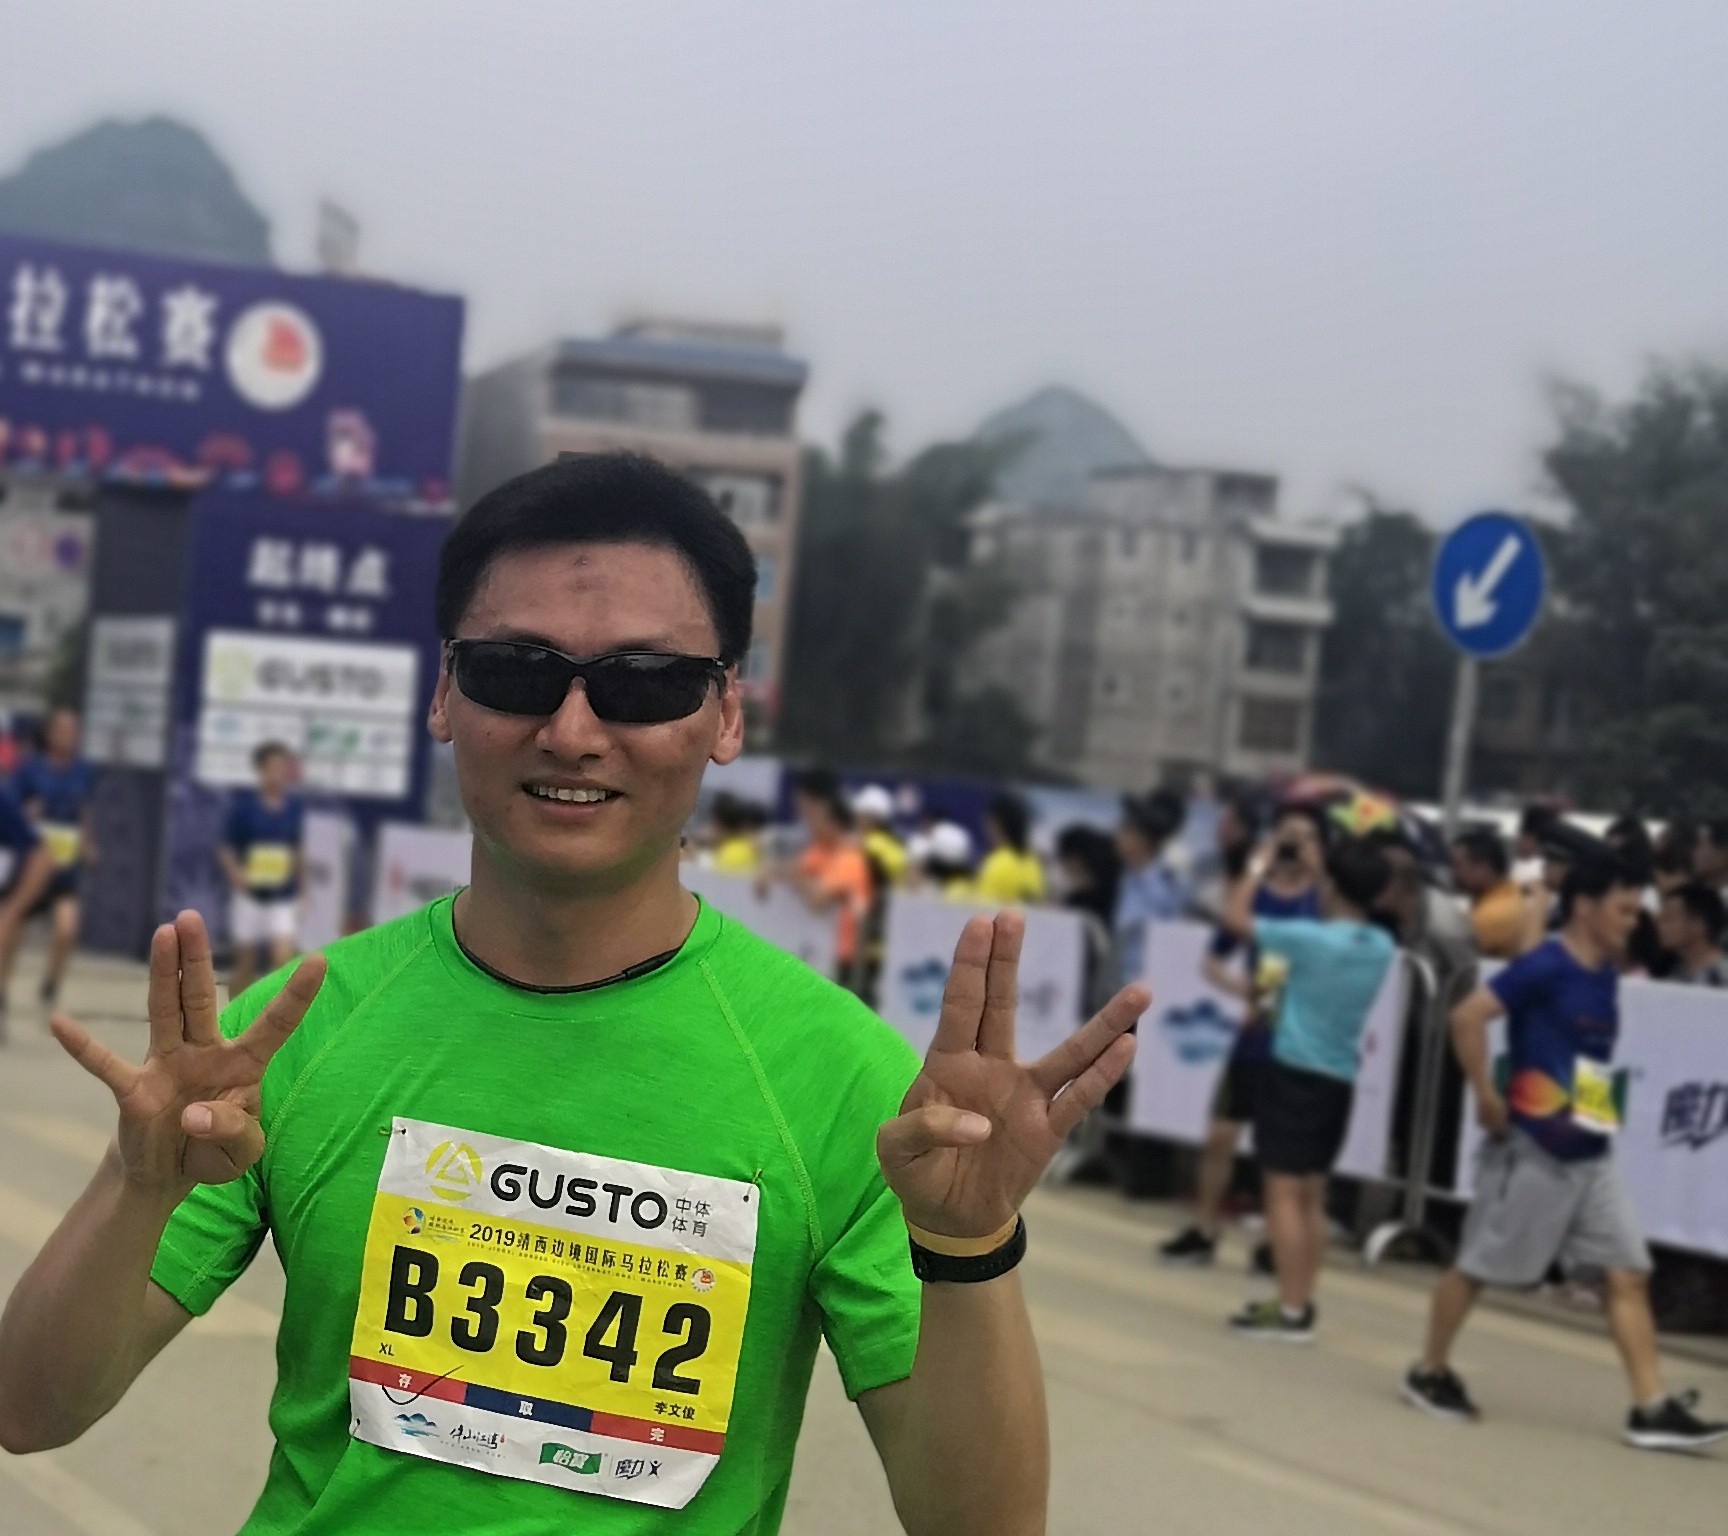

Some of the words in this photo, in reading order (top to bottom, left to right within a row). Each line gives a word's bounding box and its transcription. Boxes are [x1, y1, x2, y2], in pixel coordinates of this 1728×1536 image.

[256, 657, 385, 700] GUSTO
[490, 1163, 668, 1230] GUSTO
[675, 1197, 711, 1218] 中体
[671, 1216, 708, 1238] 体育
[469, 1222, 689, 1282] 2019靖西边境国际马拉松赛
[383, 1244, 712, 1396] B3342
[378, 1342, 394, 1357] XL
[653, 1400, 696, 1421] 李文俊
[650, 1427, 665, 1442] 完
